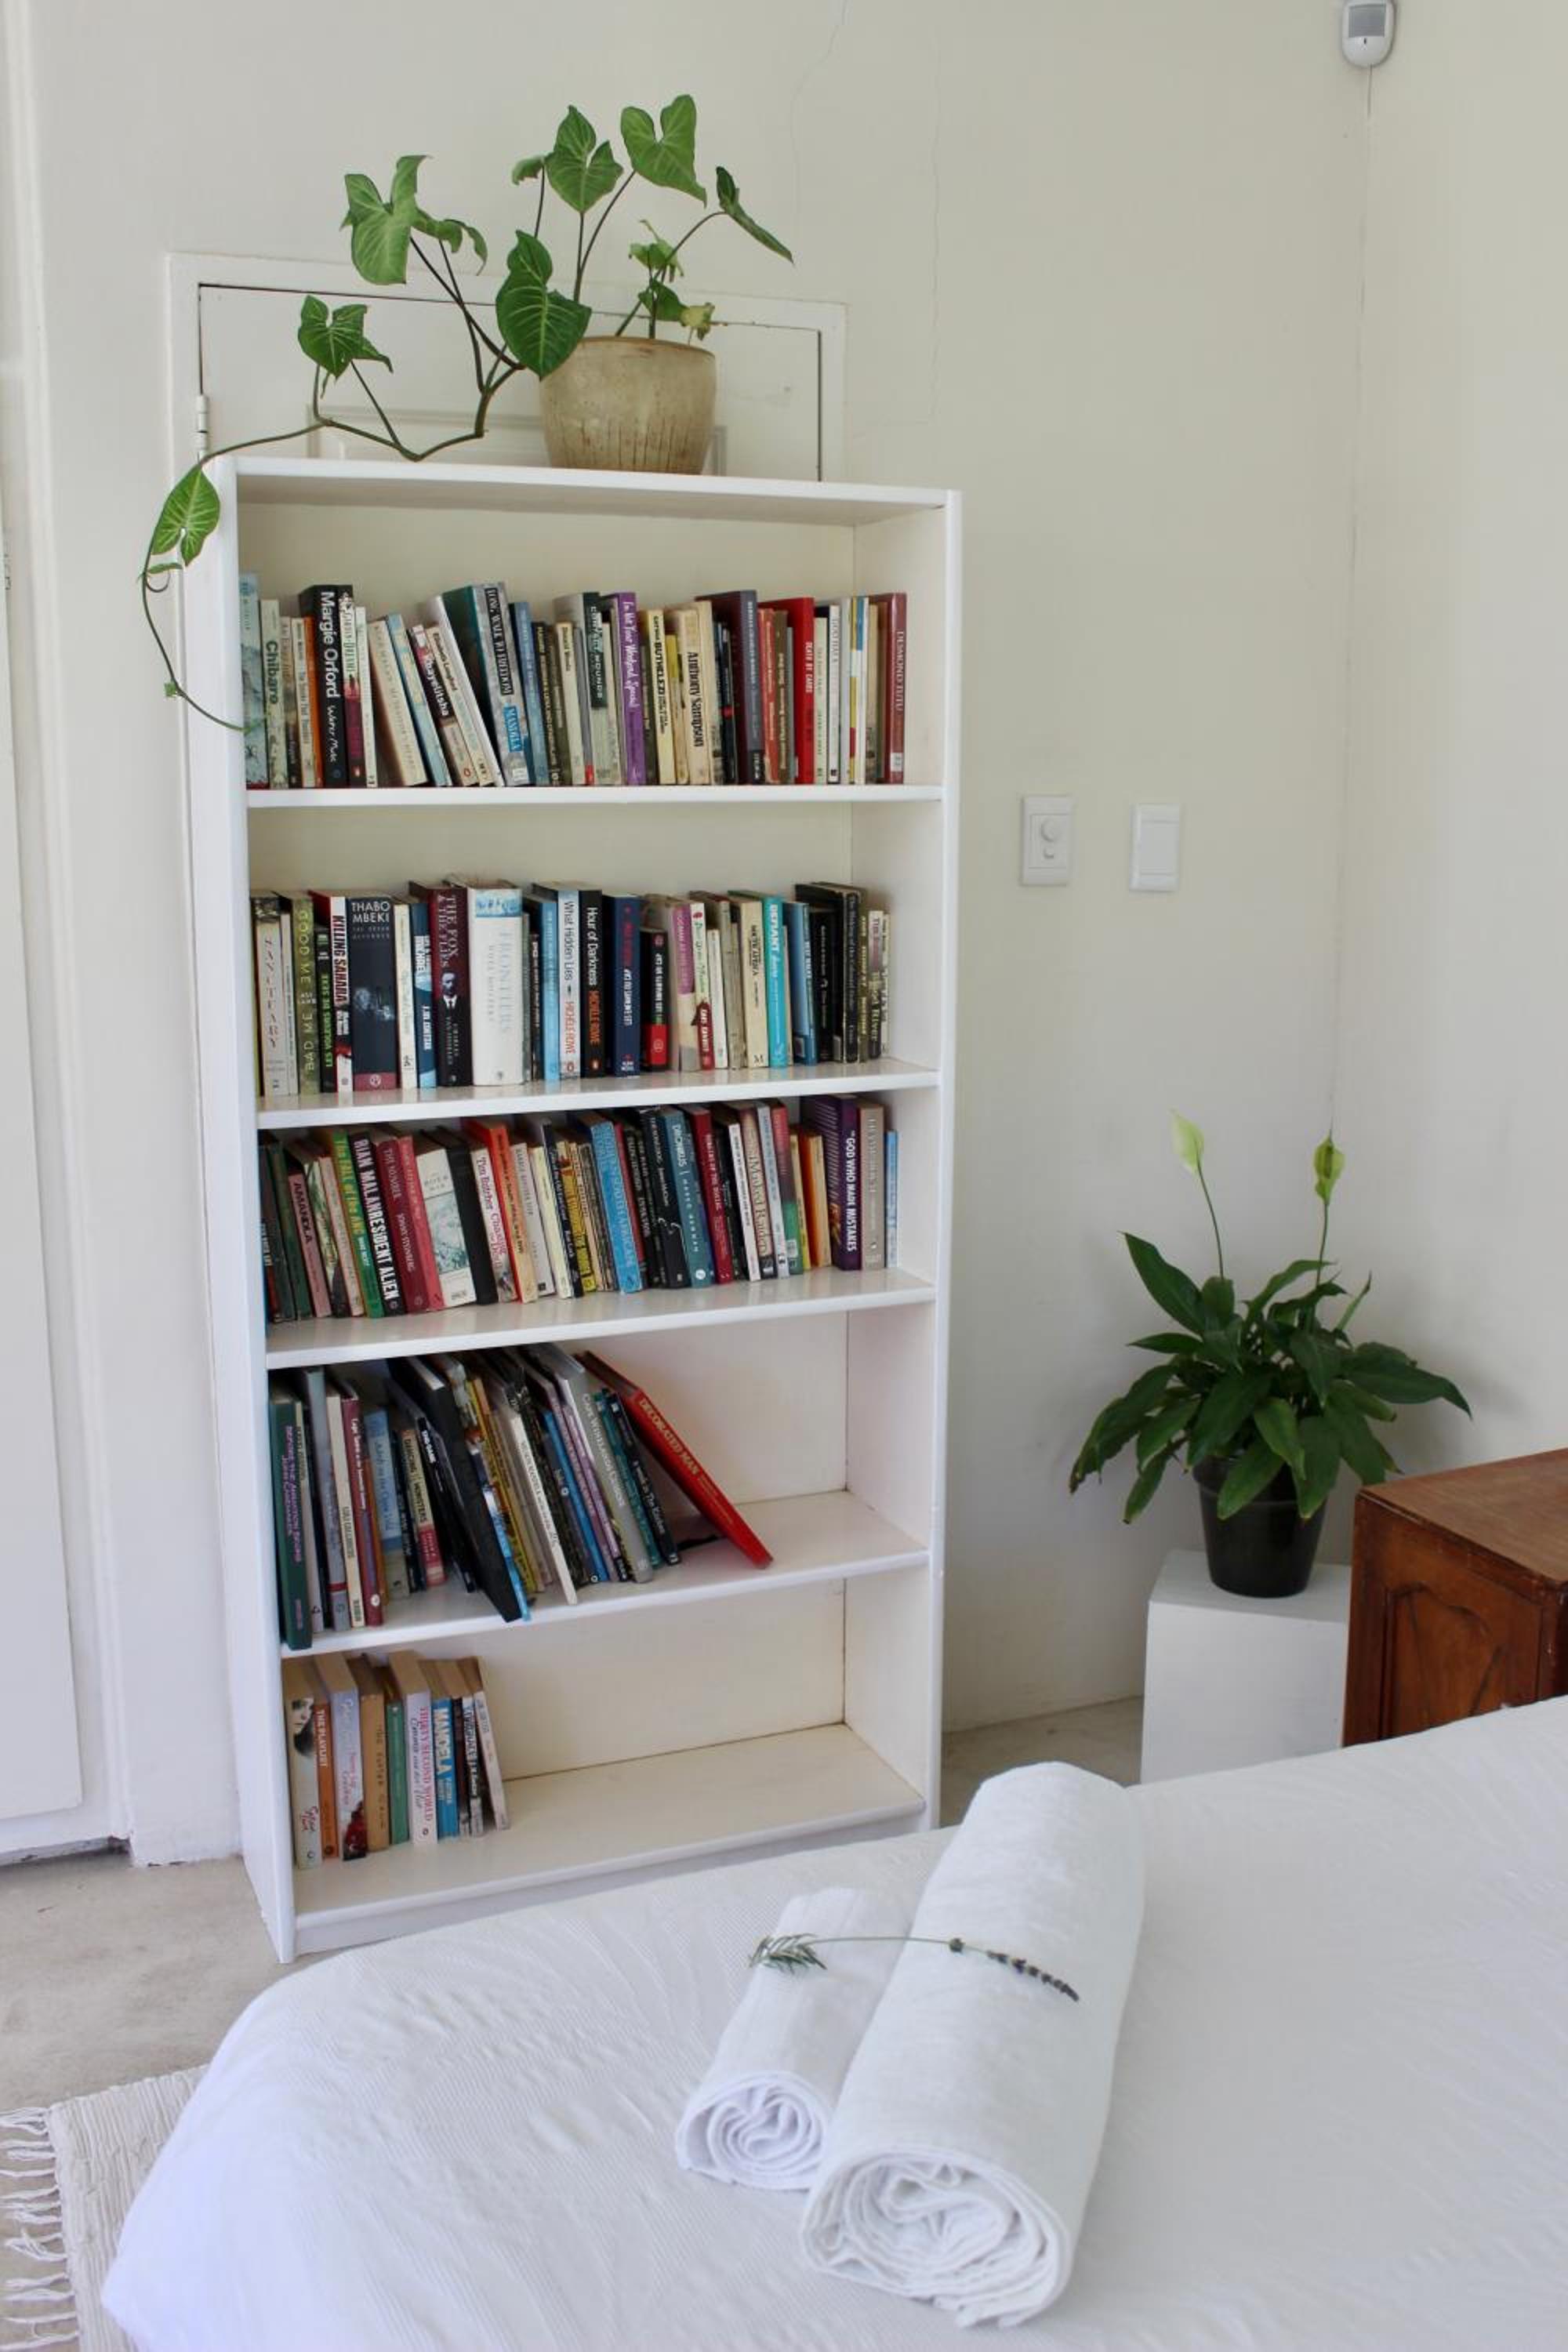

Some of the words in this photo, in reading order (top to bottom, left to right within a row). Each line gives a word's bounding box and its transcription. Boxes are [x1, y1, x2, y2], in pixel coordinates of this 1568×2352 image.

[487, 589, 498, 612] LONG
[320, 591, 337, 644] Margie
[490, 613, 503, 639] WALK
[495, 641, 505, 652] TO
[895, 630, 905, 682] DESMOND
[267, 641, 279, 705] Chibaro
[324, 648, 341, 698] Orford
[423, 652, 451, 717] Khayelitsha
[496, 653, 513, 695] FREEDOM
[593, 655, 604, 699] WOUNDS
[655, 641, 666, 695] BUTHELEZI
[687, 652, 701, 695] Anthony
[895, 683, 905, 712] TUTU
[504, 706, 521, 752] MANDELA
[690, 698, 704, 747] Sampson
[352, 901, 390, 913] THABO
[437, 894, 446, 903] &
[445, 895, 458, 924] THE
[564, 900, 575, 925] What
[299, 909, 310, 956] GOOD
[352, 912, 390, 924] MBEKI
[438, 906, 448, 932] THE
[586, 907, 598, 928] Hour
[770, 903, 780, 952] DEFIANT
[332, 914, 345, 957] KILLING
[439, 934, 450, 968] FLIES
[447, 929, 459, 957] FOX
[564, 927, 575, 961] Hidden
[587, 931, 598, 941] of
[300, 964, 311, 985] ME
[333, 958, 349, 1003] SAHARA
[564, 961, 575, 981] Lies
[587, 943, 600, 985] Darkness
[302, 1013, 314, 1033] ME
[871, 1009, 880, 1042] River
[303, 1041, 314, 1070] BAD
[354, 1138, 371, 1167] RIAN
[383, 1147, 395, 1165] THE
[845, 1137, 856, 1158] GOD
[476, 1156, 488, 1175] Tim
[845, 1158, 856, 1181] WHO
[358, 1169, 379, 1211] MALAN
[479, 1176, 494, 1210] Butcher
[845, 1182, 857, 1205] MADE
[293, 1182, 312, 1243] AMANDLA
[845, 1207, 858, 1251] MISTAKES
[491, 1212, 508, 1255] Chasing
[350, 1417, 360, 1434] Cape
[638, 1398, 684, 1456] DECORATED
[403, 1438, 419, 1473] DANCING
[414, 1482, 428, 1523] MONSTERS
